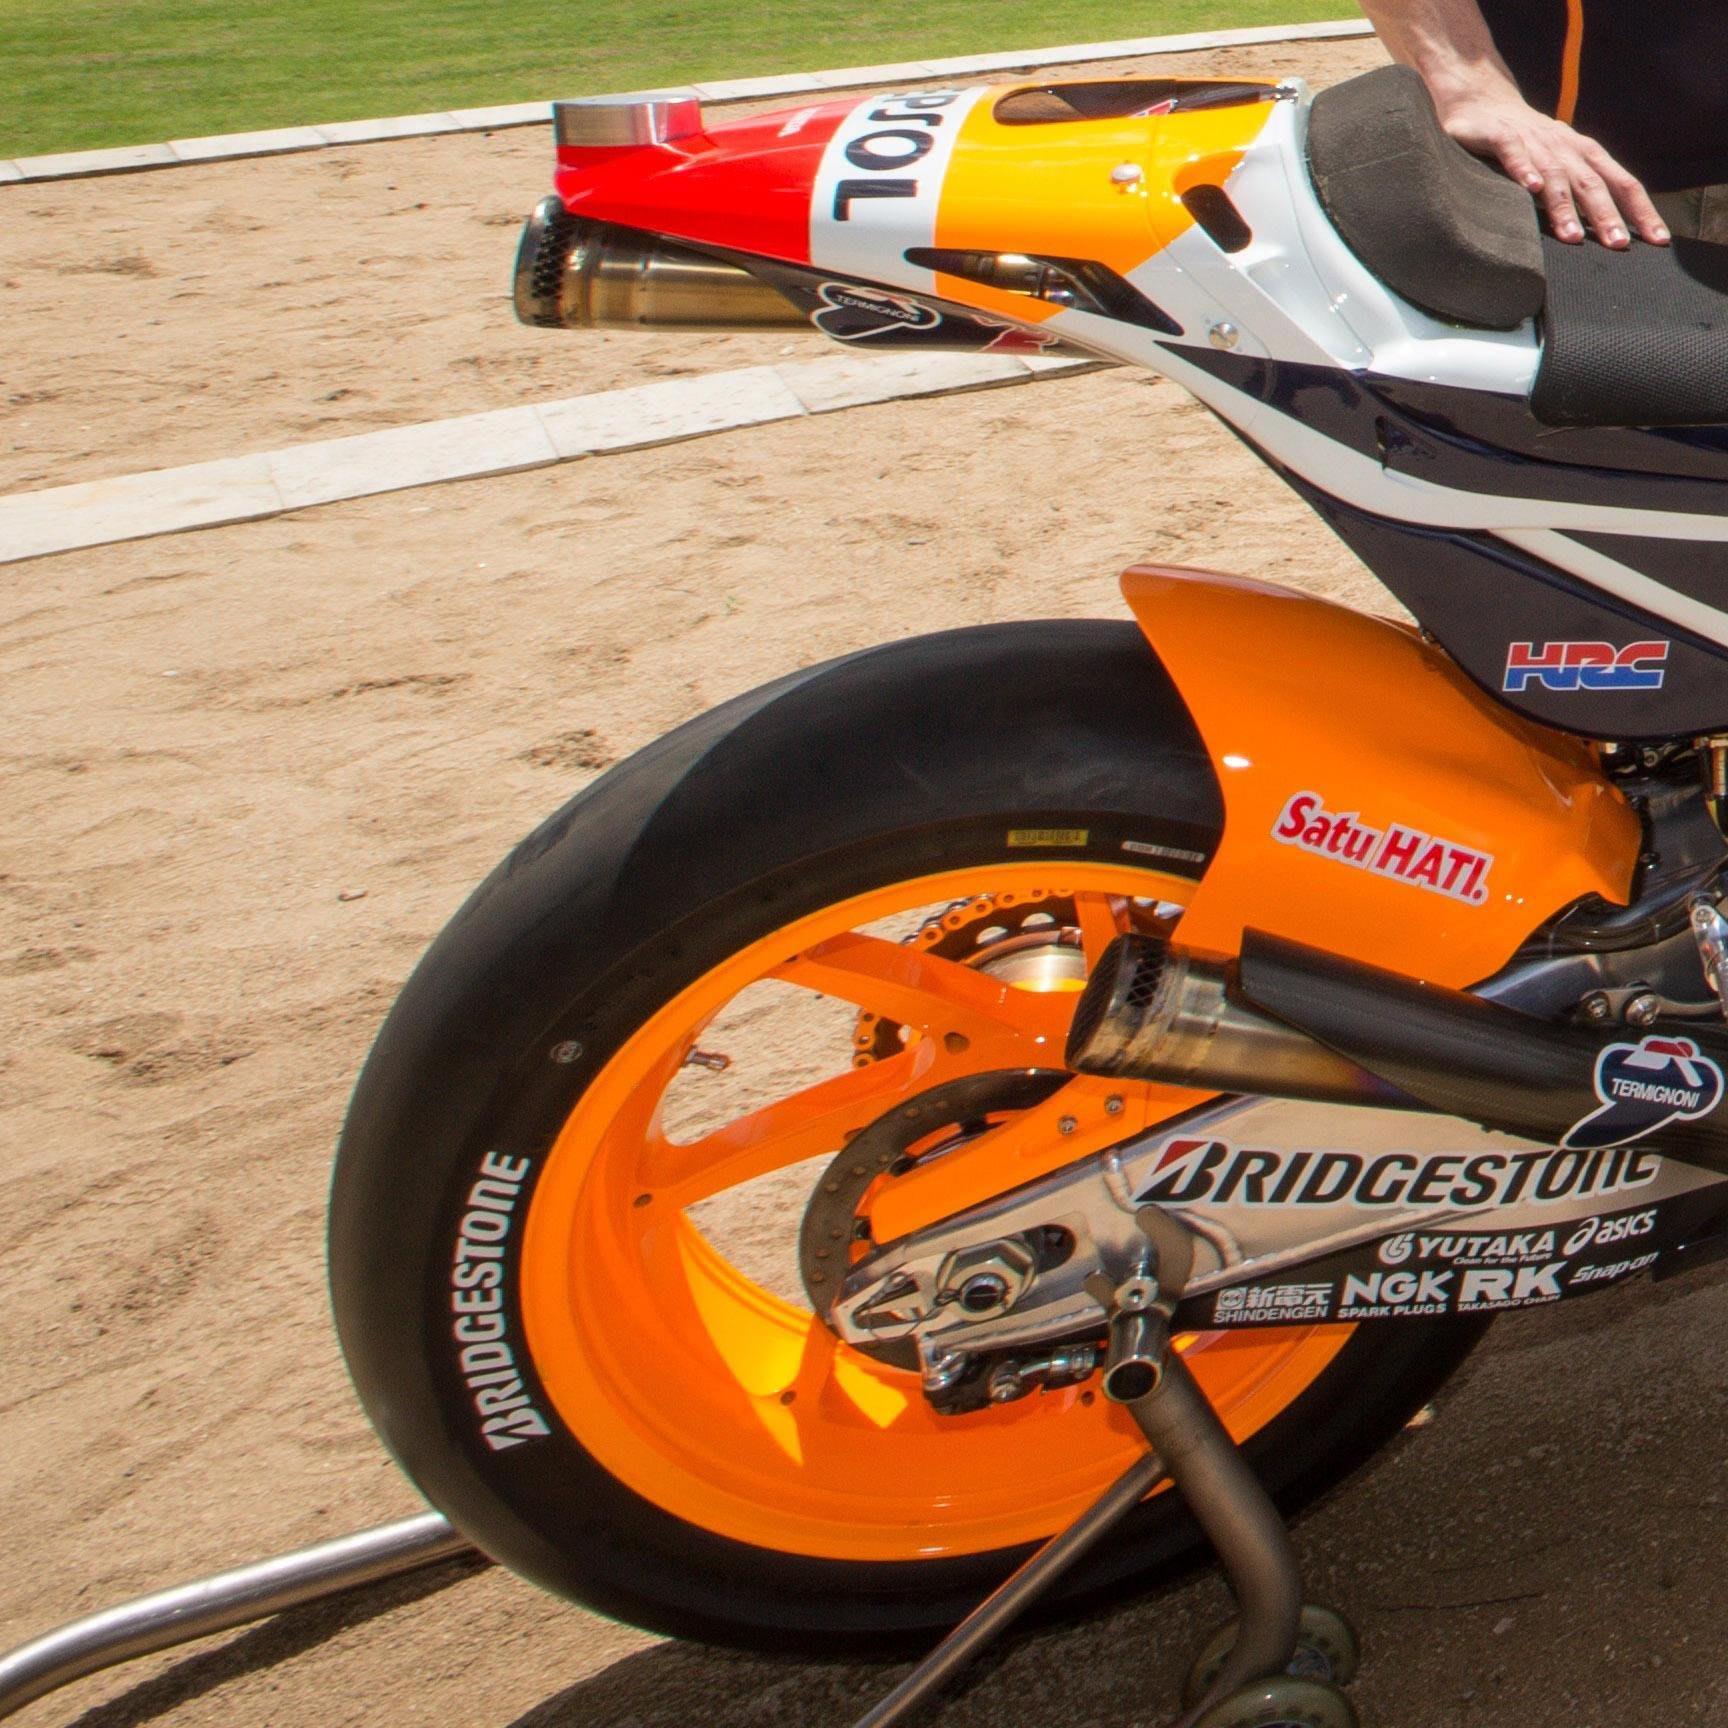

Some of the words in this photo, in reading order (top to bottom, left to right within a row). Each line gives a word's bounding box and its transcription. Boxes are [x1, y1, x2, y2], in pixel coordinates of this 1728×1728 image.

[1502, 640, 1670, 692] HRC
[1277, 795, 1377, 863] Satu
[1375, 829, 1488, 901] HATI.
[1611, 1077, 1701, 1110] TERMIGNONI
[1417, 1230, 1556, 1259] YUTAKA
[1457, 1260, 1569, 1303] RK
[1569, 1251, 1660, 1286] Snap-on
[452, 1150, 551, 1452] BRIDGESTONE
[1340, 1269, 1455, 1306] NGK
[1214, 1305, 1329, 1324] SHINDENGEN
[1337, 1305, 1391, 1319] SPARK
[1392, 1302, 1447, 1317] PLUGS
[1457, 1299, 1522, 1312] TAKASAGO
